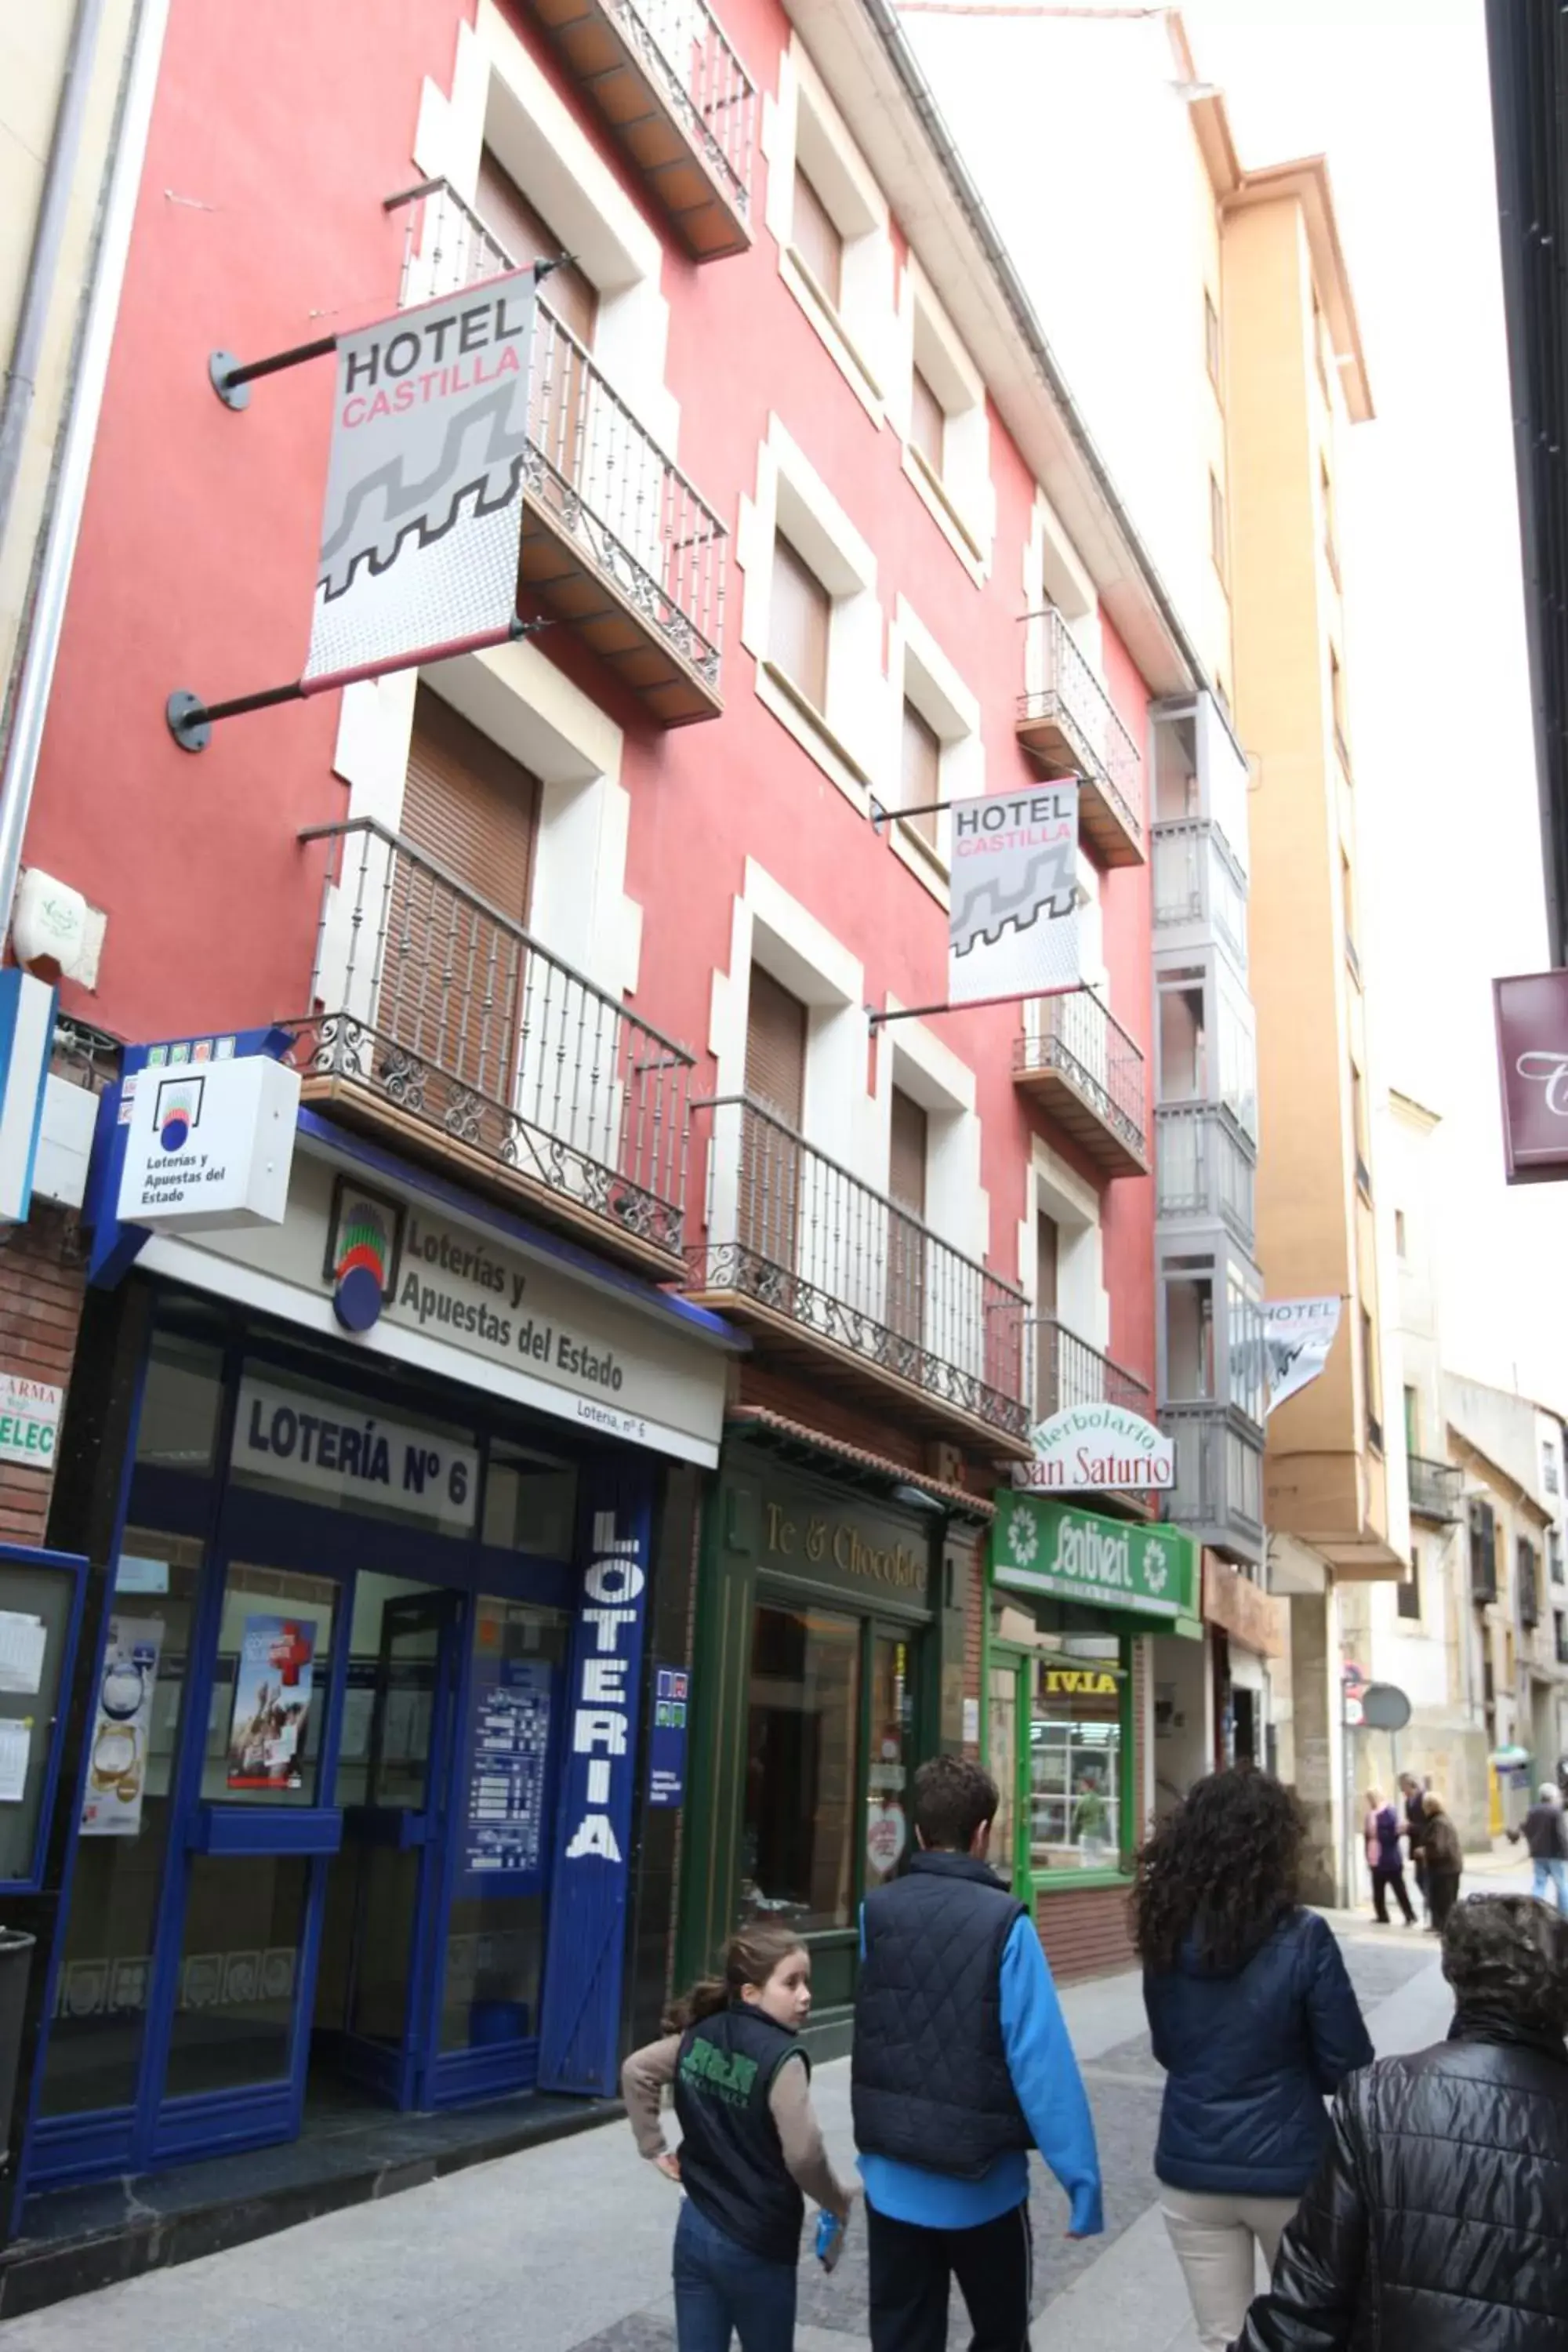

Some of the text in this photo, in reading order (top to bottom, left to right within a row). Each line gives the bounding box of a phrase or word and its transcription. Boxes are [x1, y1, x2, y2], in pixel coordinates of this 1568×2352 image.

[345, 299, 524, 394] HOTEL
[342, 346, 521, 430] CASTILLA
[956, 793, 1073, 837] HOTEL
[956, 822, 1072, 858] CASTILLA
[144, 1166, 226, 1189] Apuestas del
[200, 1154, 209, 1168] y
[141, 1188, 185, 1204] Estado
[407, 1219, 526, 1309] Loterías y
[400, 1271, 623, 1392] Apuestas del Estado
[0, 1377, 55, 1404] ARMA
[249, 1399, 390, 1484] LOTERÍA
[448, 1461, 468, 1505] 6
[1032, 1410, 1156, 1452] Herbolario
[1073, 1446, 1170, 1486] Saturio
[805, 1516, 826, 1562] &
[832, 1523, 928, 1593] Chocolate
[1051, 1514, 1134, 1588] Santiveri
[565, 1511, 645, 1863] LOTERIA
